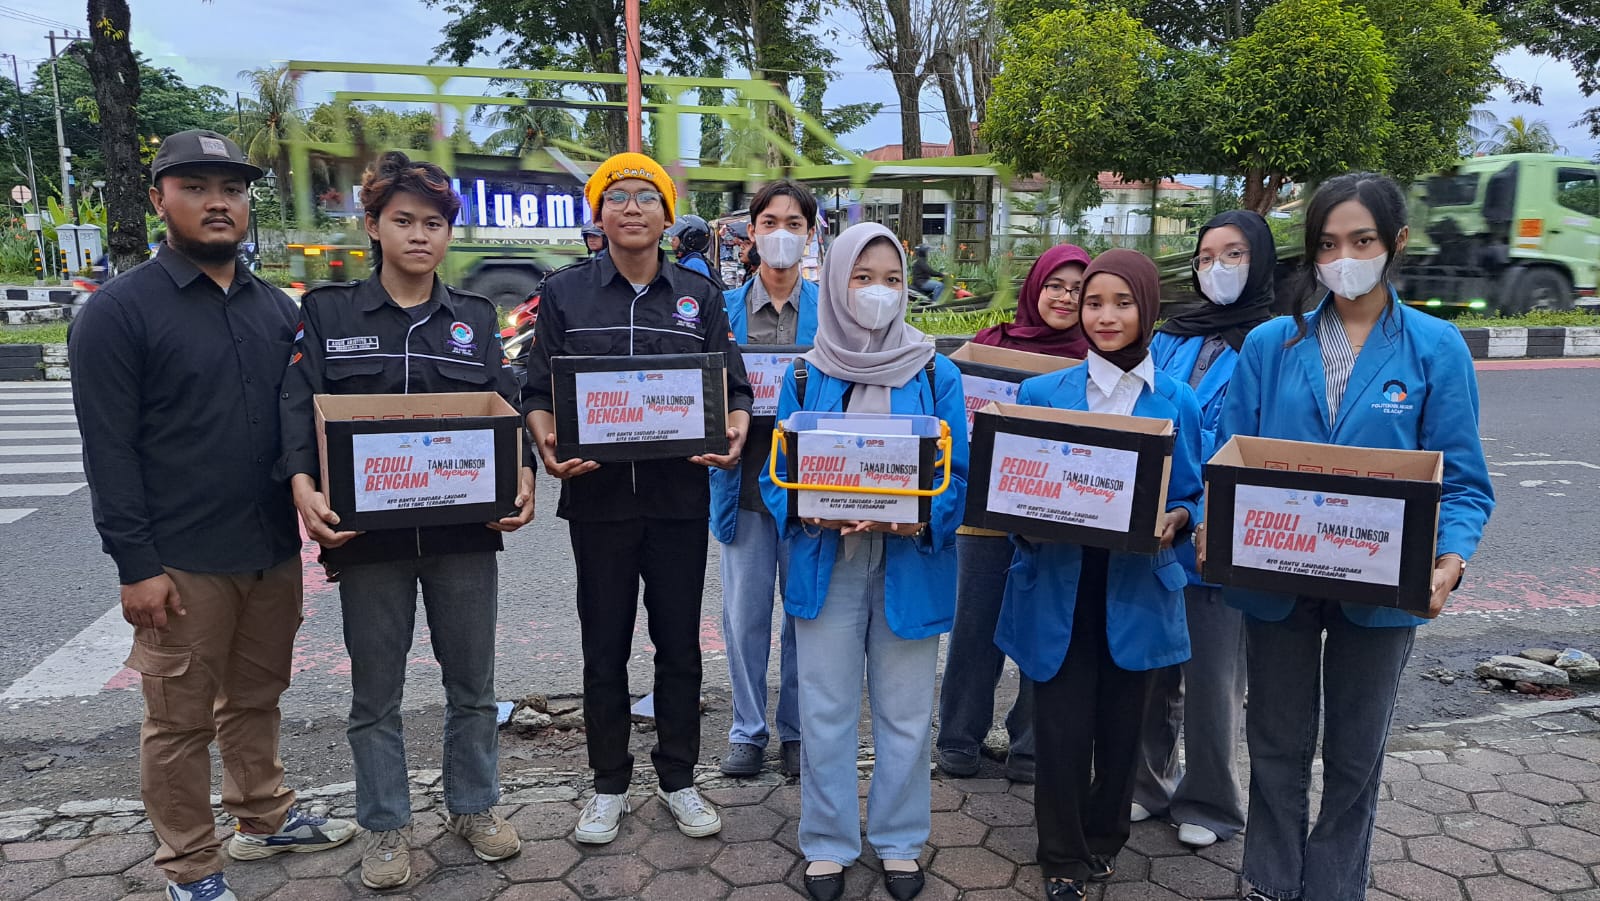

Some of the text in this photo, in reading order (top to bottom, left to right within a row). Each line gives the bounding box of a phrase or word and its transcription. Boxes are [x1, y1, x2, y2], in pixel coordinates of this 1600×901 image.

[586, 391, 629, 408] PEDULI
[642, 395, 694, 405] TANAH LONGSOR
[587, 407, 643, 424] BENCANA
[364, 456, 413, 474] PEDULI
[428, 458, 485, 469] TANAH LONGSOR
[800, 456, 846, 472] PEDULI
[860, 462, 917, 474] TANAH LONGSOR
[1000, 457, 1048, 478] PEDULI
[365, 472, 428, 491] BENCANA
[998, 476, 1062, 499] BENCANA
[1063, 471, 1123, 491] TANAH LONGSOR
[1244, 510, 1300, 531] PEDULI
[1244, 529, 1316, 553] BENCANA
[1317, 522, 1389, 542] TANAH LONGSOR
[1323, 533, 1380, 556] Majenang
